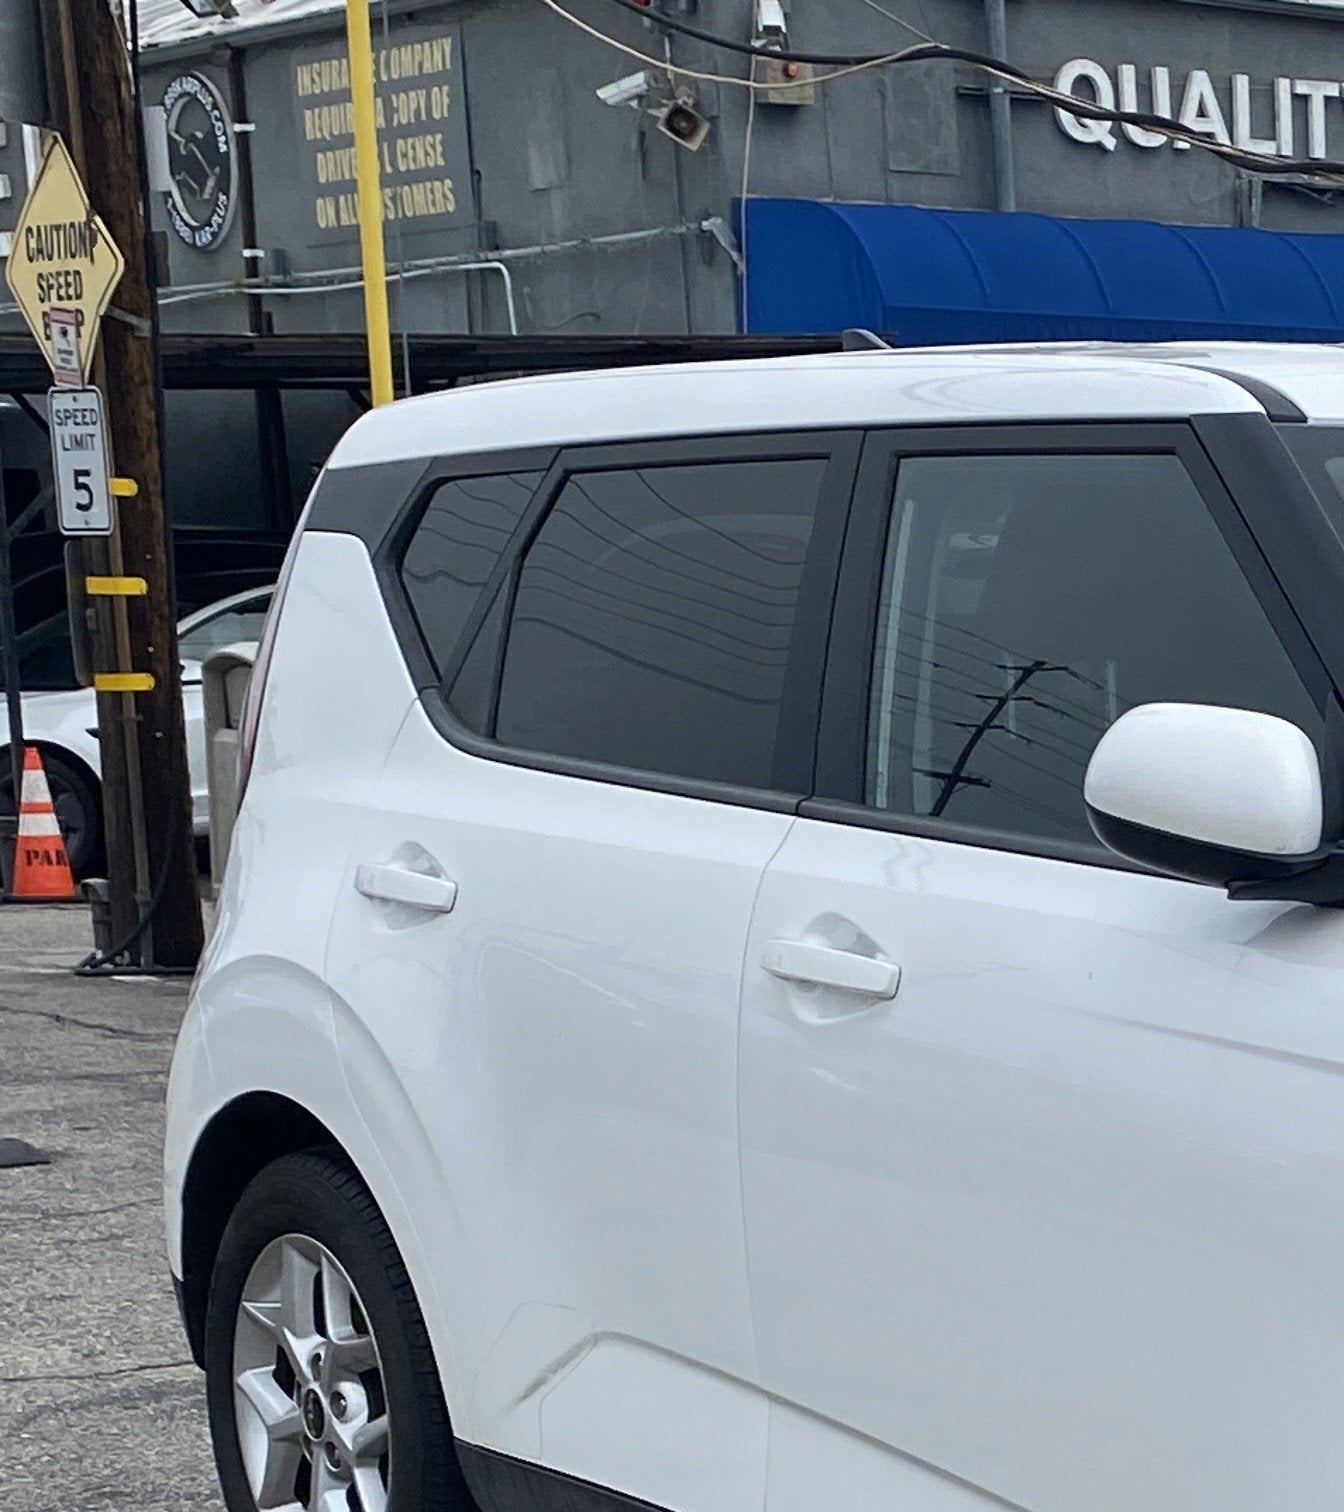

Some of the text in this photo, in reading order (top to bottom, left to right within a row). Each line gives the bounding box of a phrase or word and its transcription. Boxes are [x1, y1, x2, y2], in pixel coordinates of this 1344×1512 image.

[297, 51, 376, 96] INSURA
[431, 84, 450, 120] OF
[382, 133, 445, 174] LCENSE
[316, 196, 338, 229] ON
[380, 178, 456, 220] STOMERS
[37, 269, 84, 304] SPEED
[42, 308, 85, 341] BP
[55, 408, 98, 427] SPEED
[60, 433, 96, 452] LIMIT
[73, 468, 94, 512] 5
